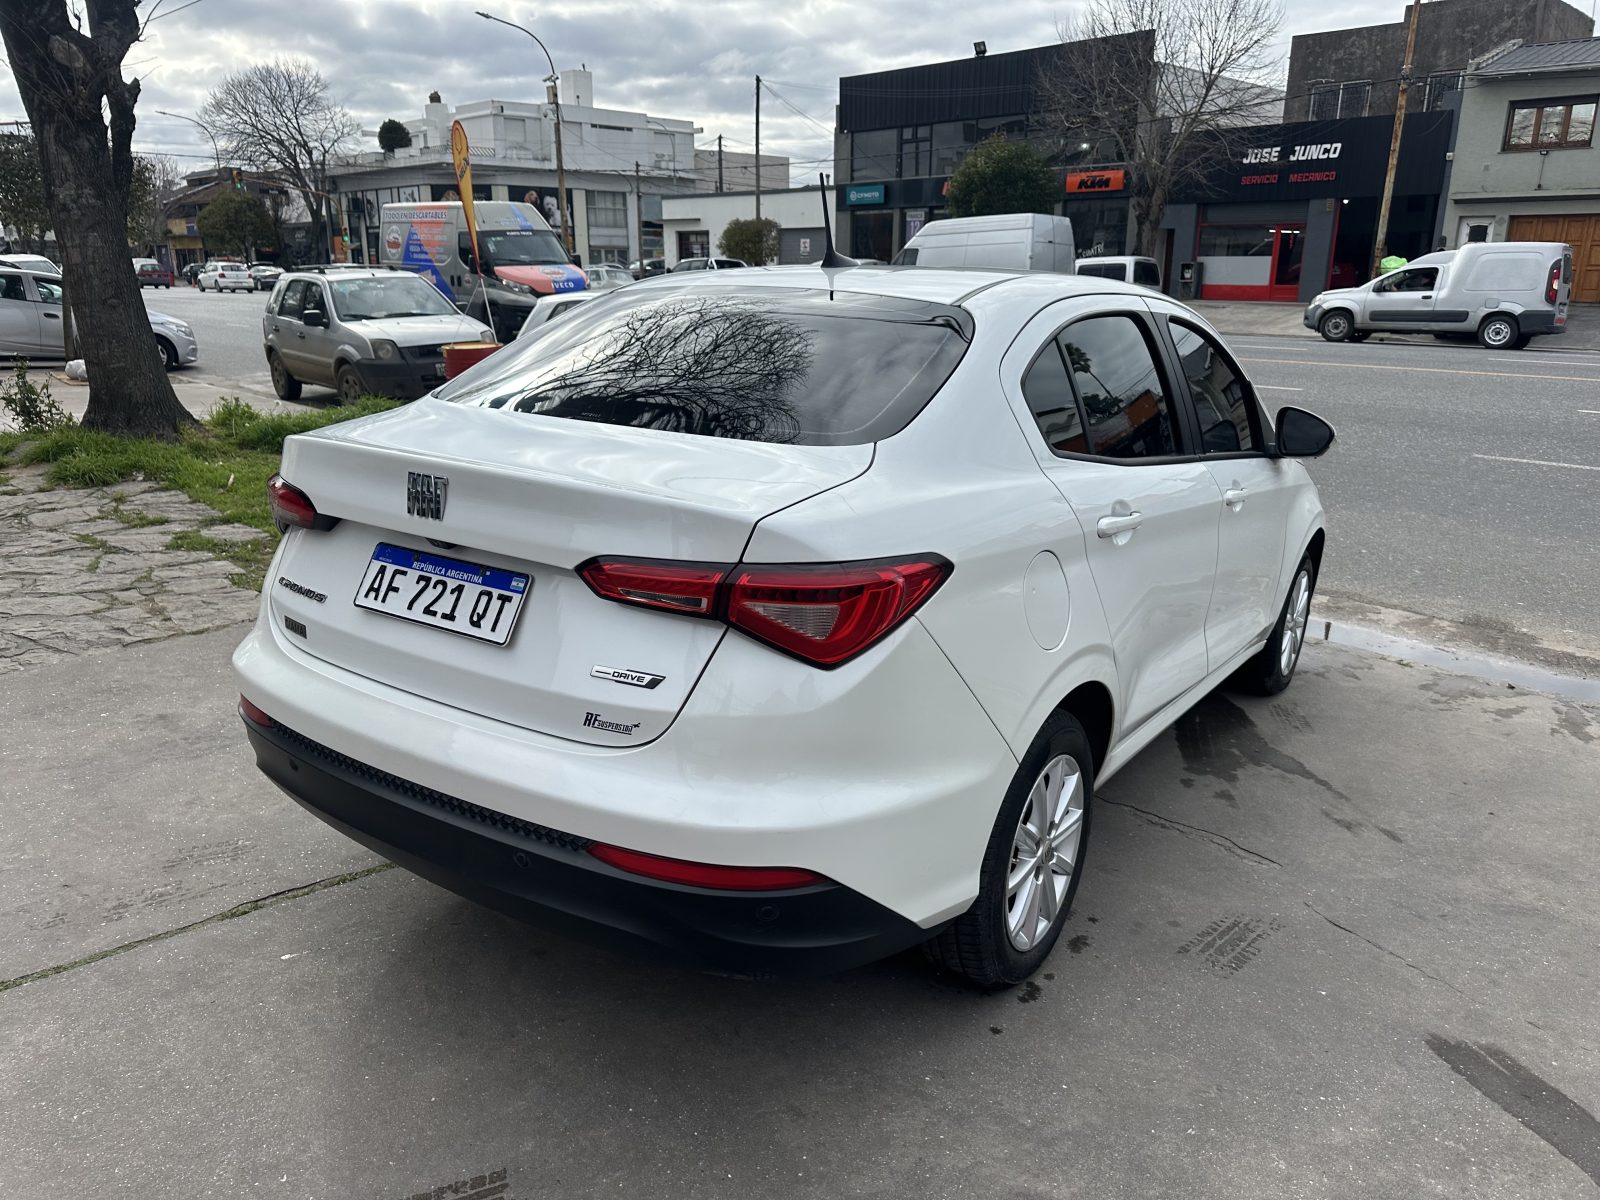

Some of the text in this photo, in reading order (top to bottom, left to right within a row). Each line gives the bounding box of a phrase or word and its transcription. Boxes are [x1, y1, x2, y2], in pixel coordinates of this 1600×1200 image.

[1243, 143, 1342, 164] JOSE JUNCO
[1077, 177, 1111, 189] KTM
[1241, 171, 1336, 185] SERVICIO MECANICO
[385, 211, 447, 219] TODO EN DESCARTABLES
[551, 281, 574, 289] IVECO
[412, 561, 483, 584] REPÚBLICA ARGENTINA
[278, 576, 328, 604] CRONOS
[363, 564, 514, 633] AF 721 QT
[611, 671, 646, 683] DRIVE
